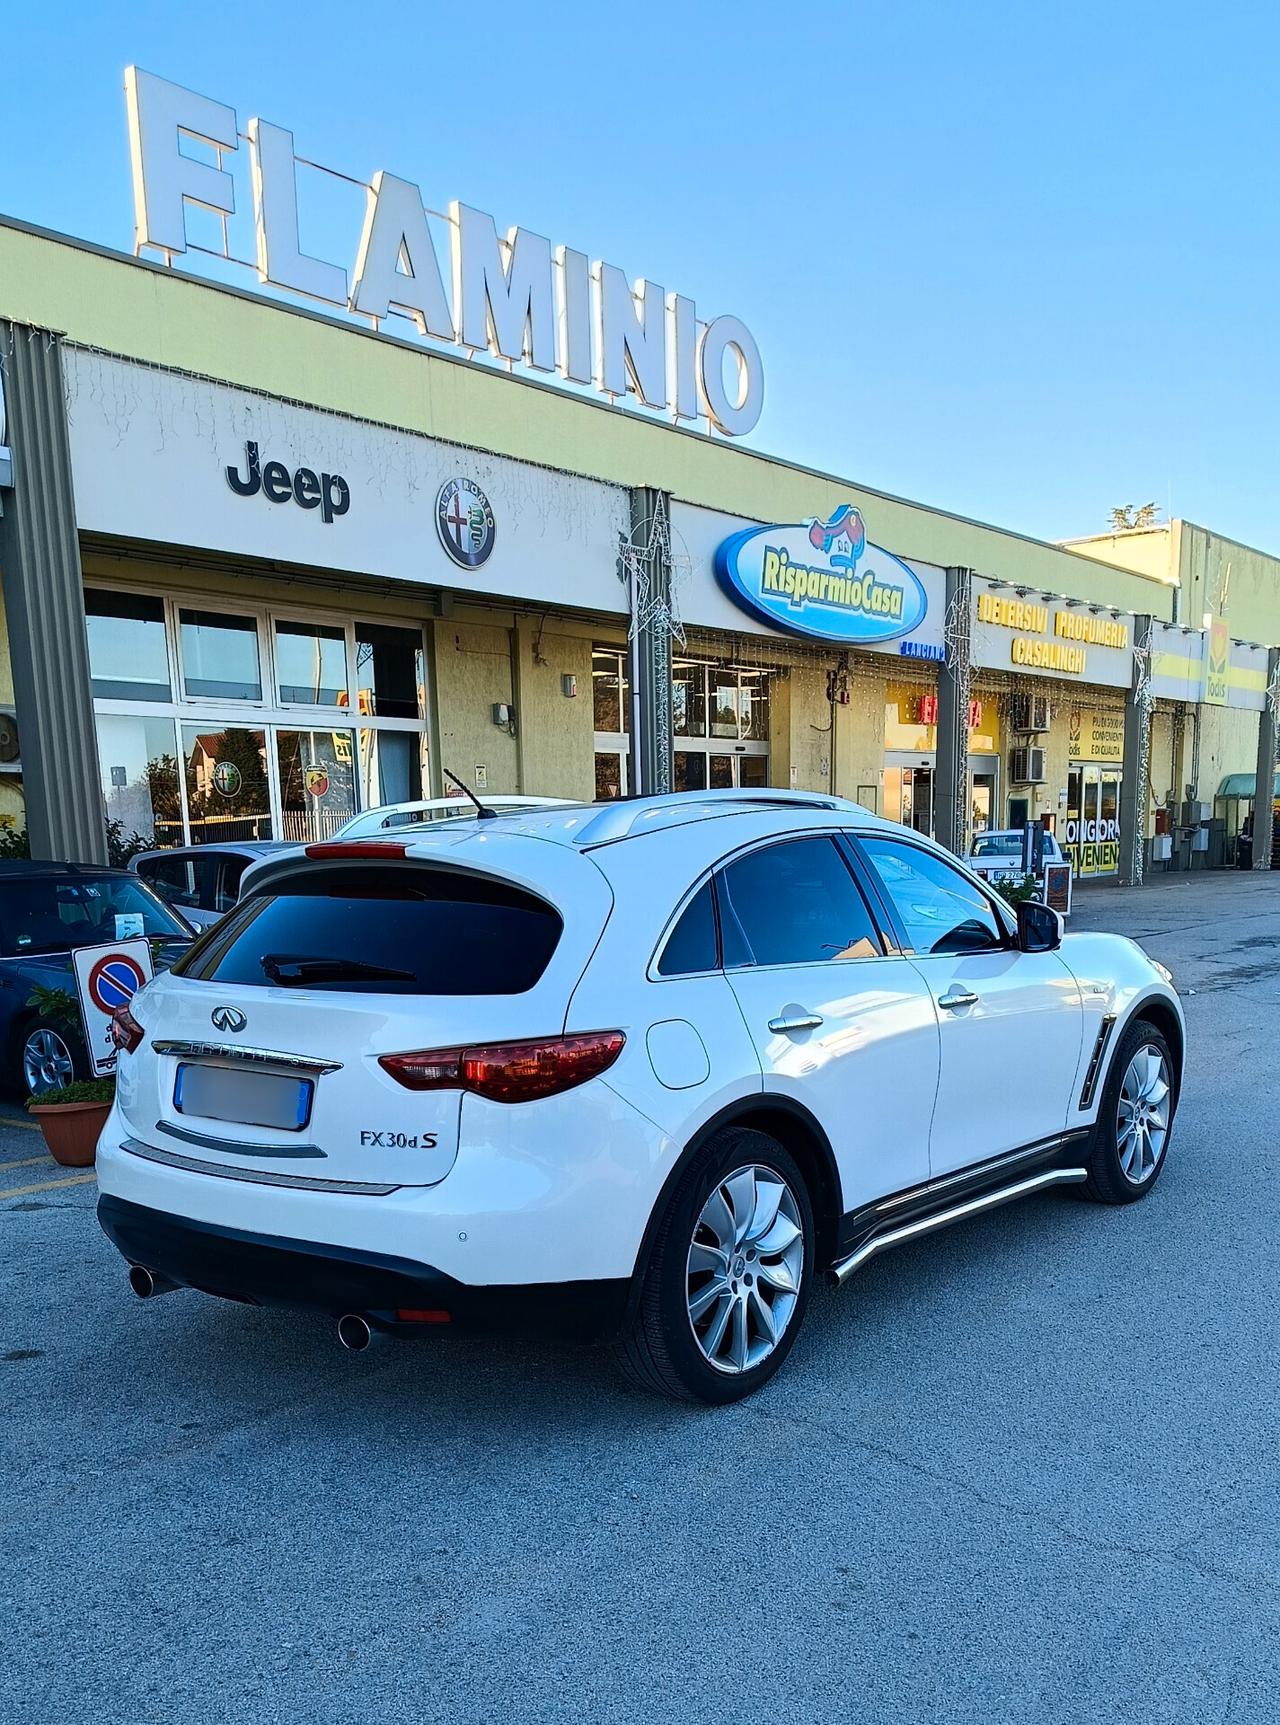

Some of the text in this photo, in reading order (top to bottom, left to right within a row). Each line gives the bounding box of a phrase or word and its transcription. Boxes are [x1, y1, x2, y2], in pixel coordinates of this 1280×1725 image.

[124, 64, 764, 437] FLAMINIO
[225, 440, 351, 524] Jeep
[440, 480, 494, 528] ALFA ROMEO
[762, 545, 904, 619] RisparmioCasa
[1055, 611, 1128, 649] PROFUMERIA
[1012, 637, 1087, 673] CASALINGHI
[1207, 676, 1226, 698] Todis
[360, 1130, 438, 1149] FX30d S
